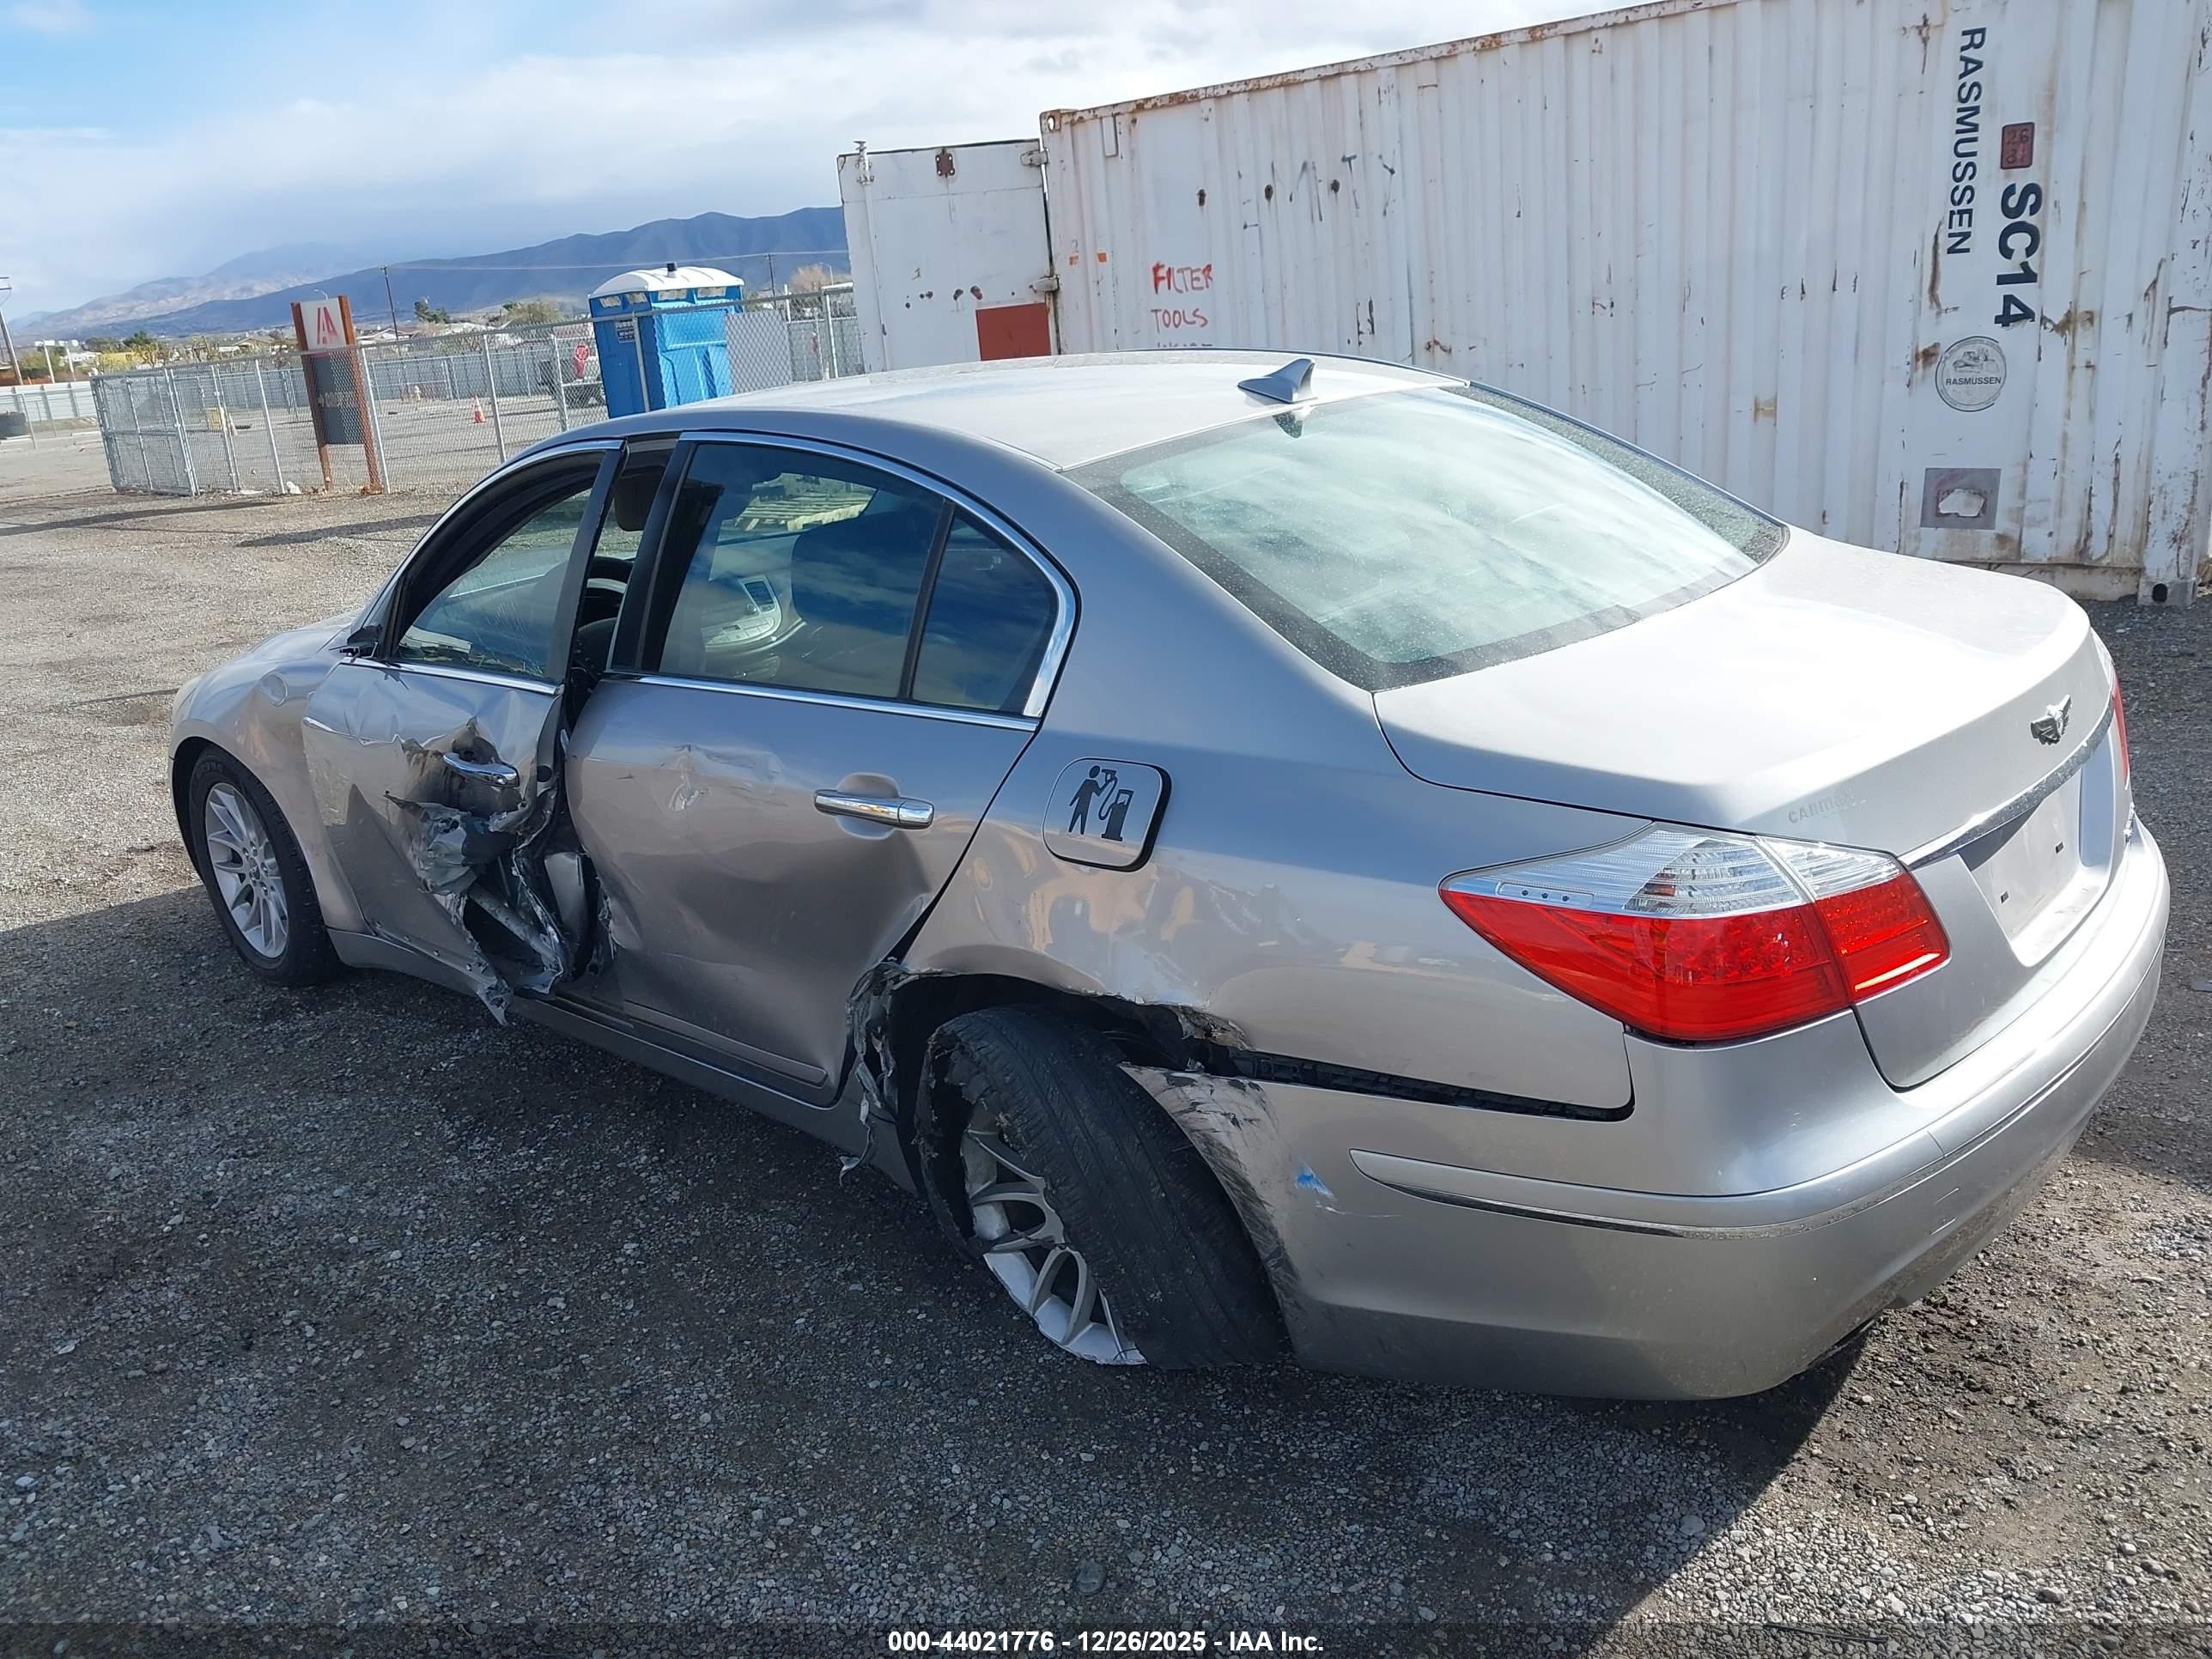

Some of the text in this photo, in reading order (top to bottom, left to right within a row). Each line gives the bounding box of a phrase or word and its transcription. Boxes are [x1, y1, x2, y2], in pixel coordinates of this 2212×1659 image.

[1946, 27, 1987, 255] RASMUSSEN
[1994, 182, 2043, 327] SC14
[1152, 262, 1213, 295] FILTER
[1150, 307, 1209, 334] TOOLS
[1945, 376, 2002, 386] RASMUSSEN
